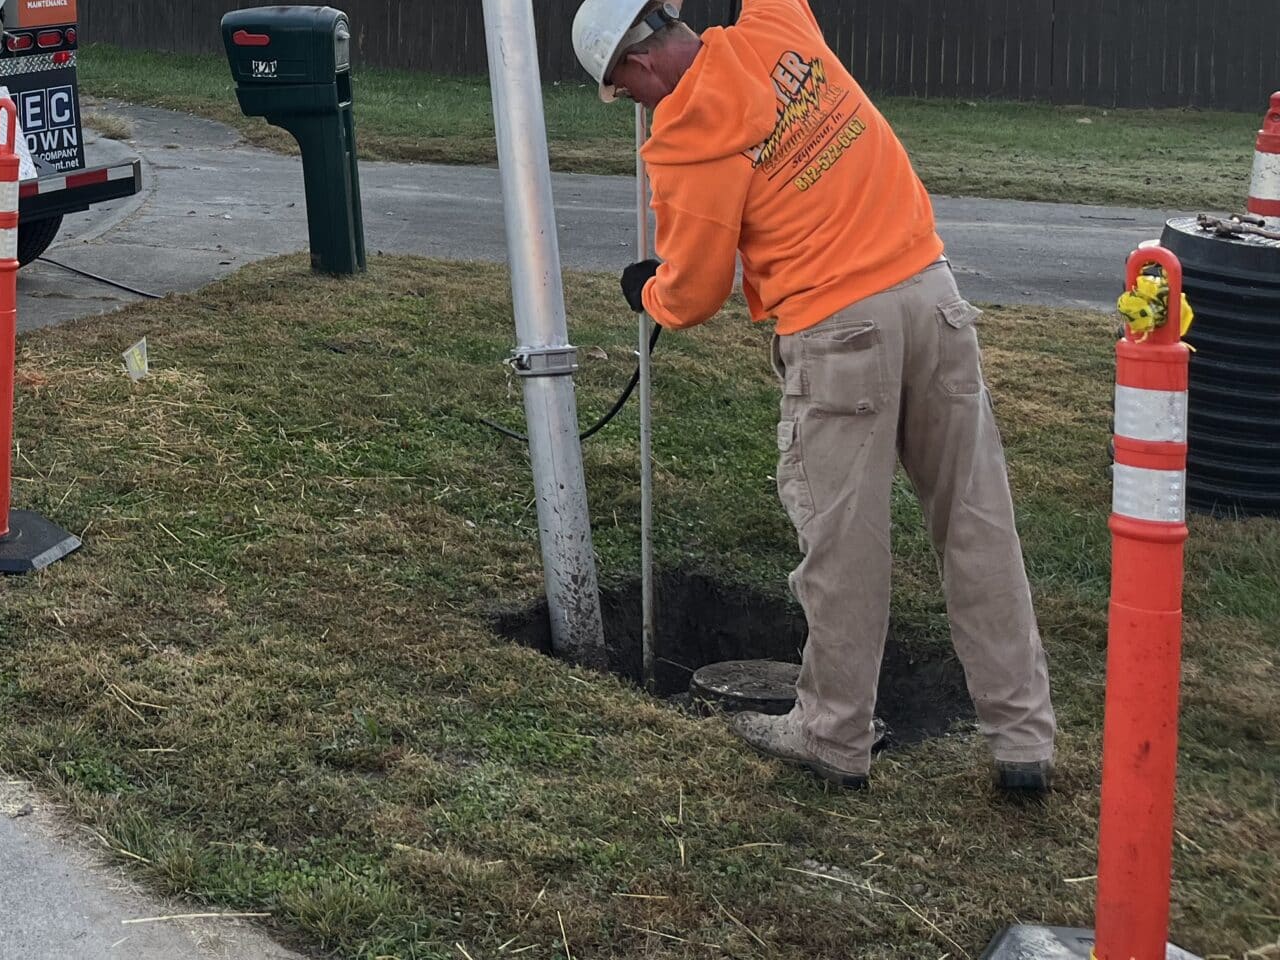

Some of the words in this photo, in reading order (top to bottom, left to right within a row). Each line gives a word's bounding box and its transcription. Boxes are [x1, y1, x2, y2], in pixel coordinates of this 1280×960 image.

[25, 92, 71, 128] EC
[25, 127, 78, 154] OWN
[40, 148, 78, 161] COMPANY
[794, 116, 867, 191] 812-522-6467
